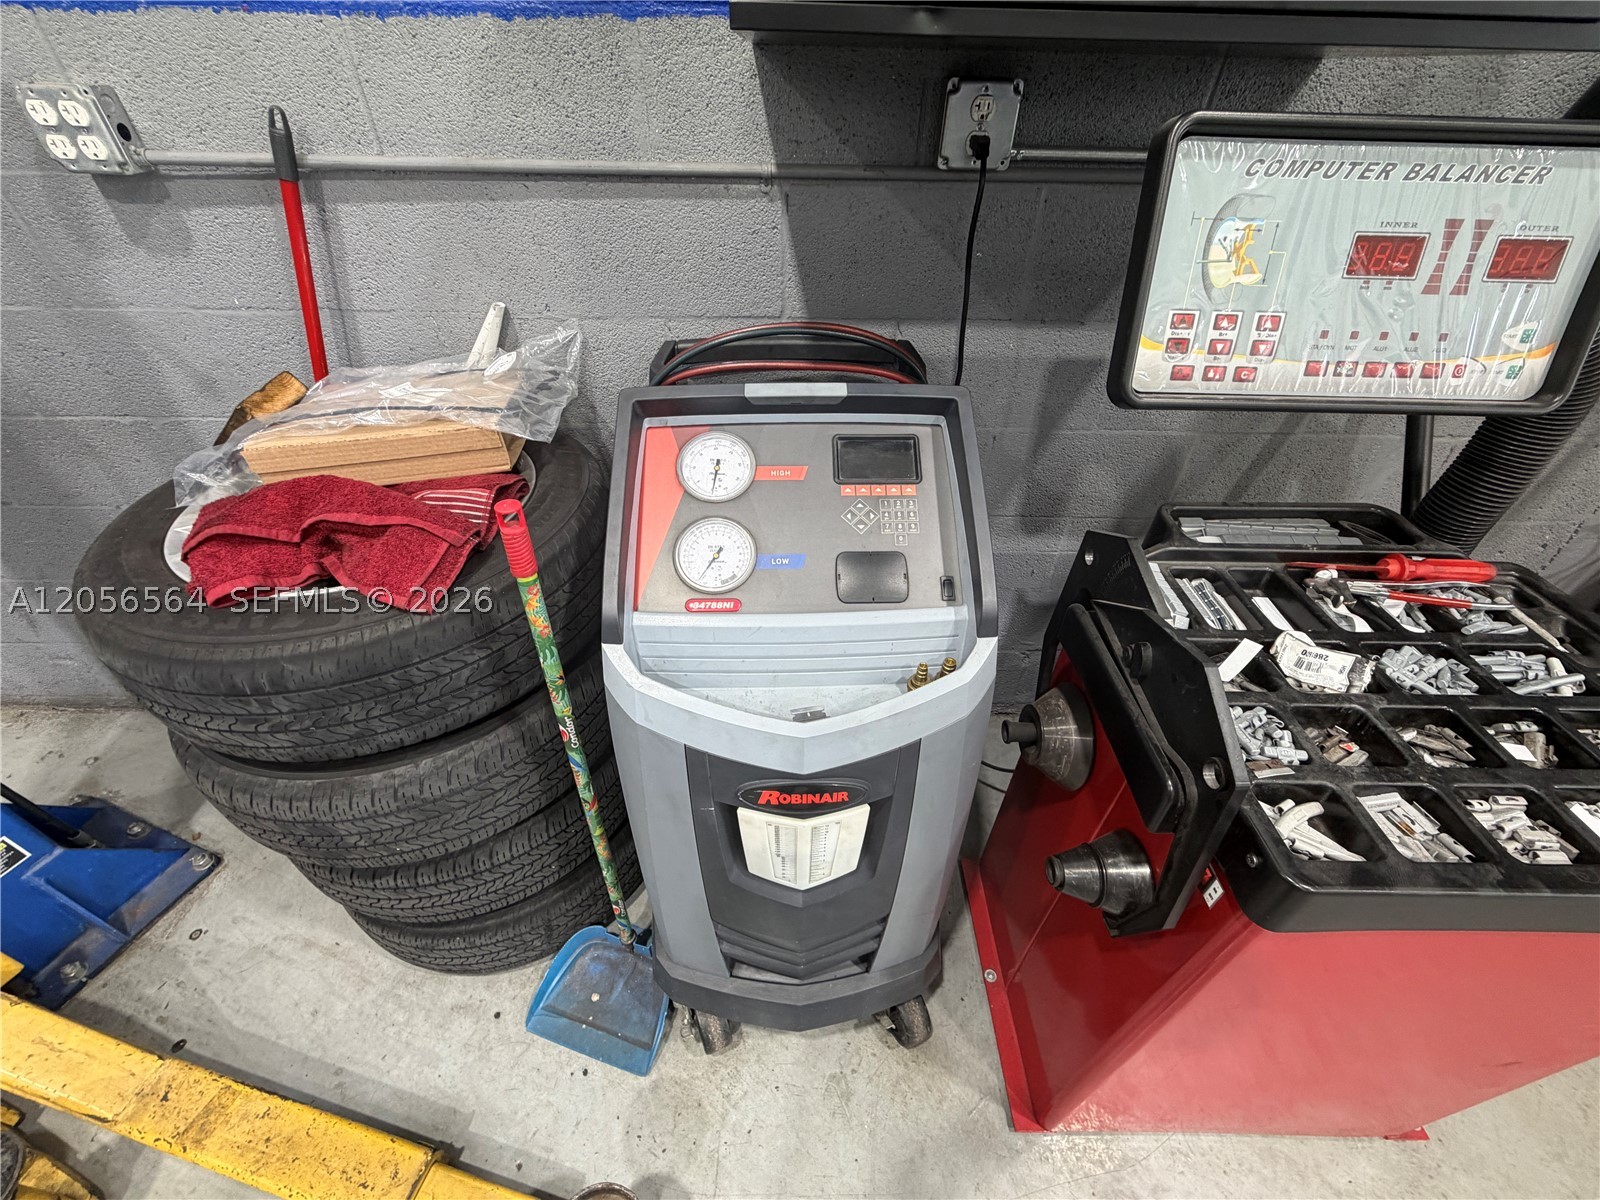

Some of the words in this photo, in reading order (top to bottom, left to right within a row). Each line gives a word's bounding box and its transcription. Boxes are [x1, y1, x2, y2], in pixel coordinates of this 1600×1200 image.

[1244, 158, 1399, 181] COMPUTER
[1402, 162, 1553, 185] BALANCER
[1380, 221, 1418, 229] INNER
[1520, 224, 1559, 233] OUTER
[770, 469, 791, 477] HIGH
[564, 716, 580, 749] Condor
[757, 789, 849, 805] ROBINAIR
